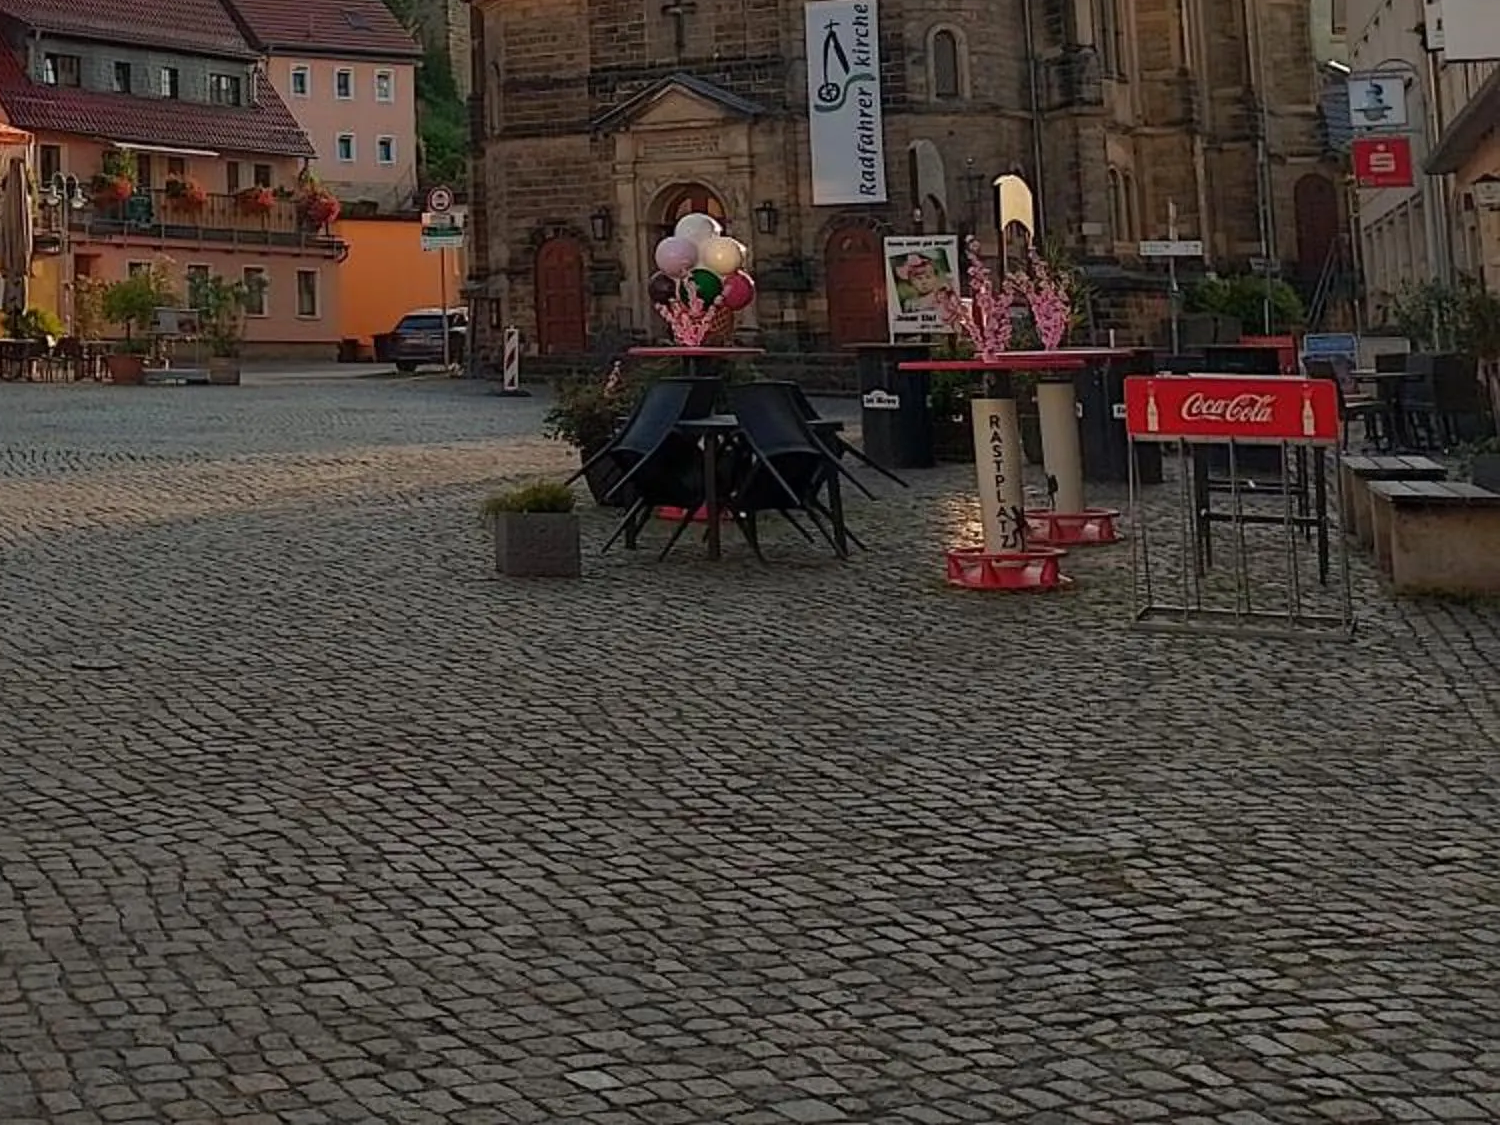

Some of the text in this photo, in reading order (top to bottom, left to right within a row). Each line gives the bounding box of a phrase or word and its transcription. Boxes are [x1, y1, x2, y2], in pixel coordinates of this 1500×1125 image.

[852, 4, 879, 197] Radfahrer kirche
[1181, 392, 1277, 422] Coca-Cola
[988, 414, 1010, 549] RASTPLATZ
